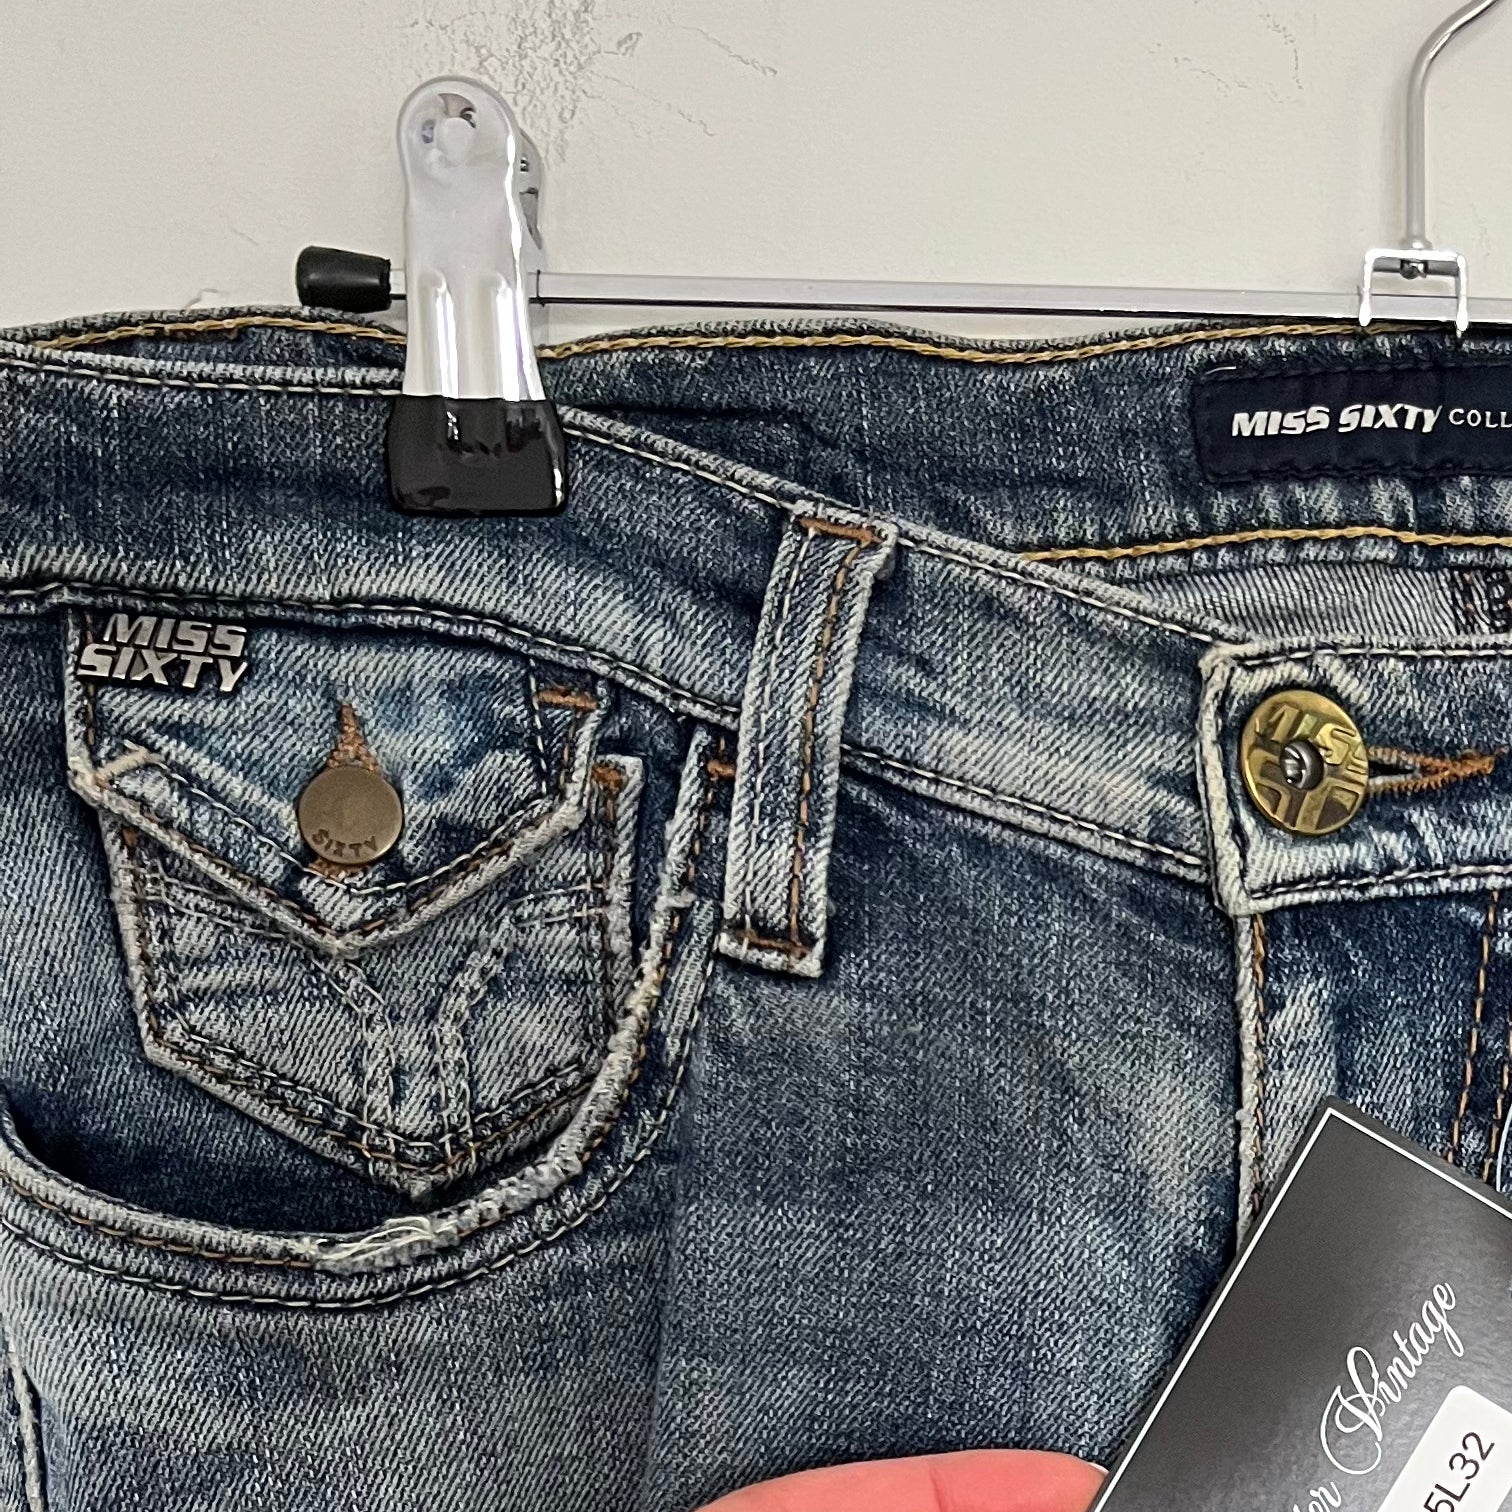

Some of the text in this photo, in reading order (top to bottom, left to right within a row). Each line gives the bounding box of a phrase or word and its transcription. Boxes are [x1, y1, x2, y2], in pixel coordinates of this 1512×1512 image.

[1231, 405, 1330, 437] MISS
[1337, 403, 1442, 433] SIXTY
[102, 612, 248, 657] MISS
[76, 642, 248, 693] SIXTY
[311, 828, 378, 858] SIXTY
[1319, 1282, 1465, 1475] Vintage
